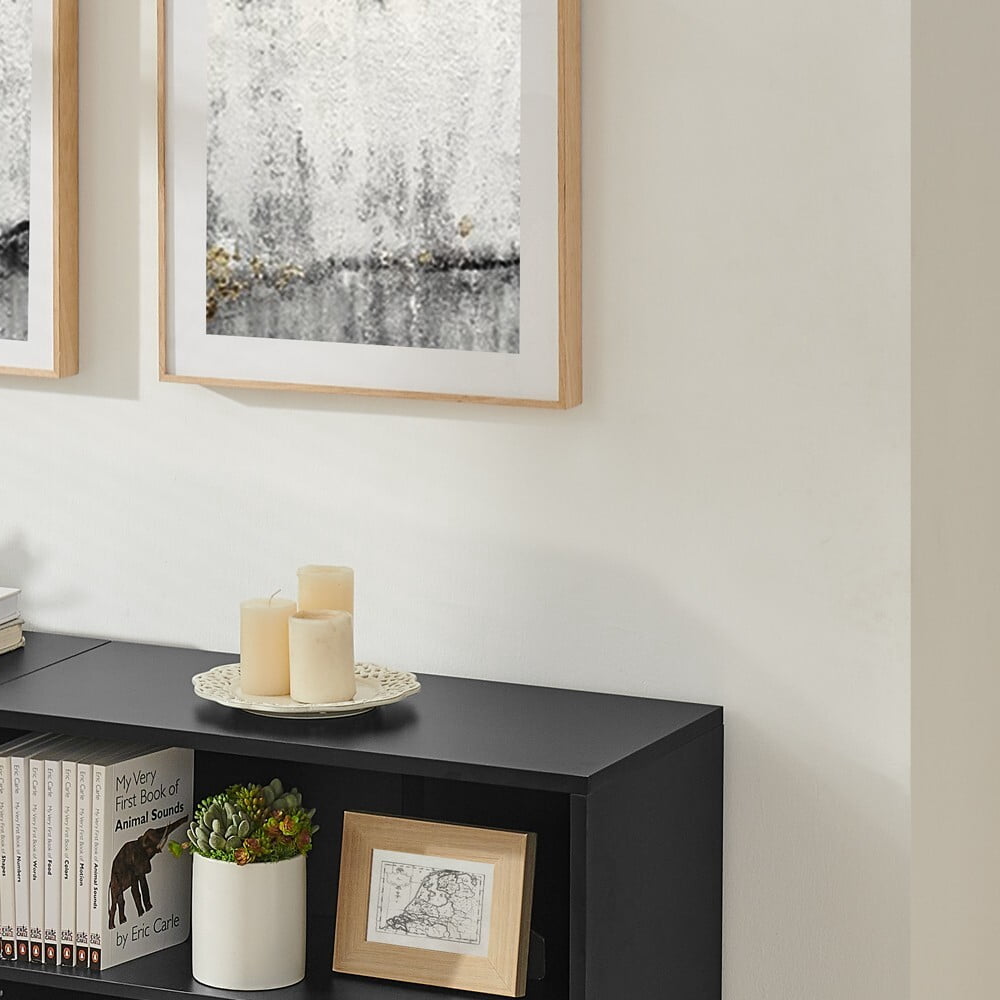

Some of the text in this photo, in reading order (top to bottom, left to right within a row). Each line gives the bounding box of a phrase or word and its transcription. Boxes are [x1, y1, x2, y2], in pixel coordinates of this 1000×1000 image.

[115, 778, 181, 812] First Book of
[116, 770, 157, 794] My Very
[115, 801, 184, 832] Animal Sounds
[116, 932, 128, 949] by
[131, 923, 150, 942] Eric
[153, 914, 180, 934] Carle
